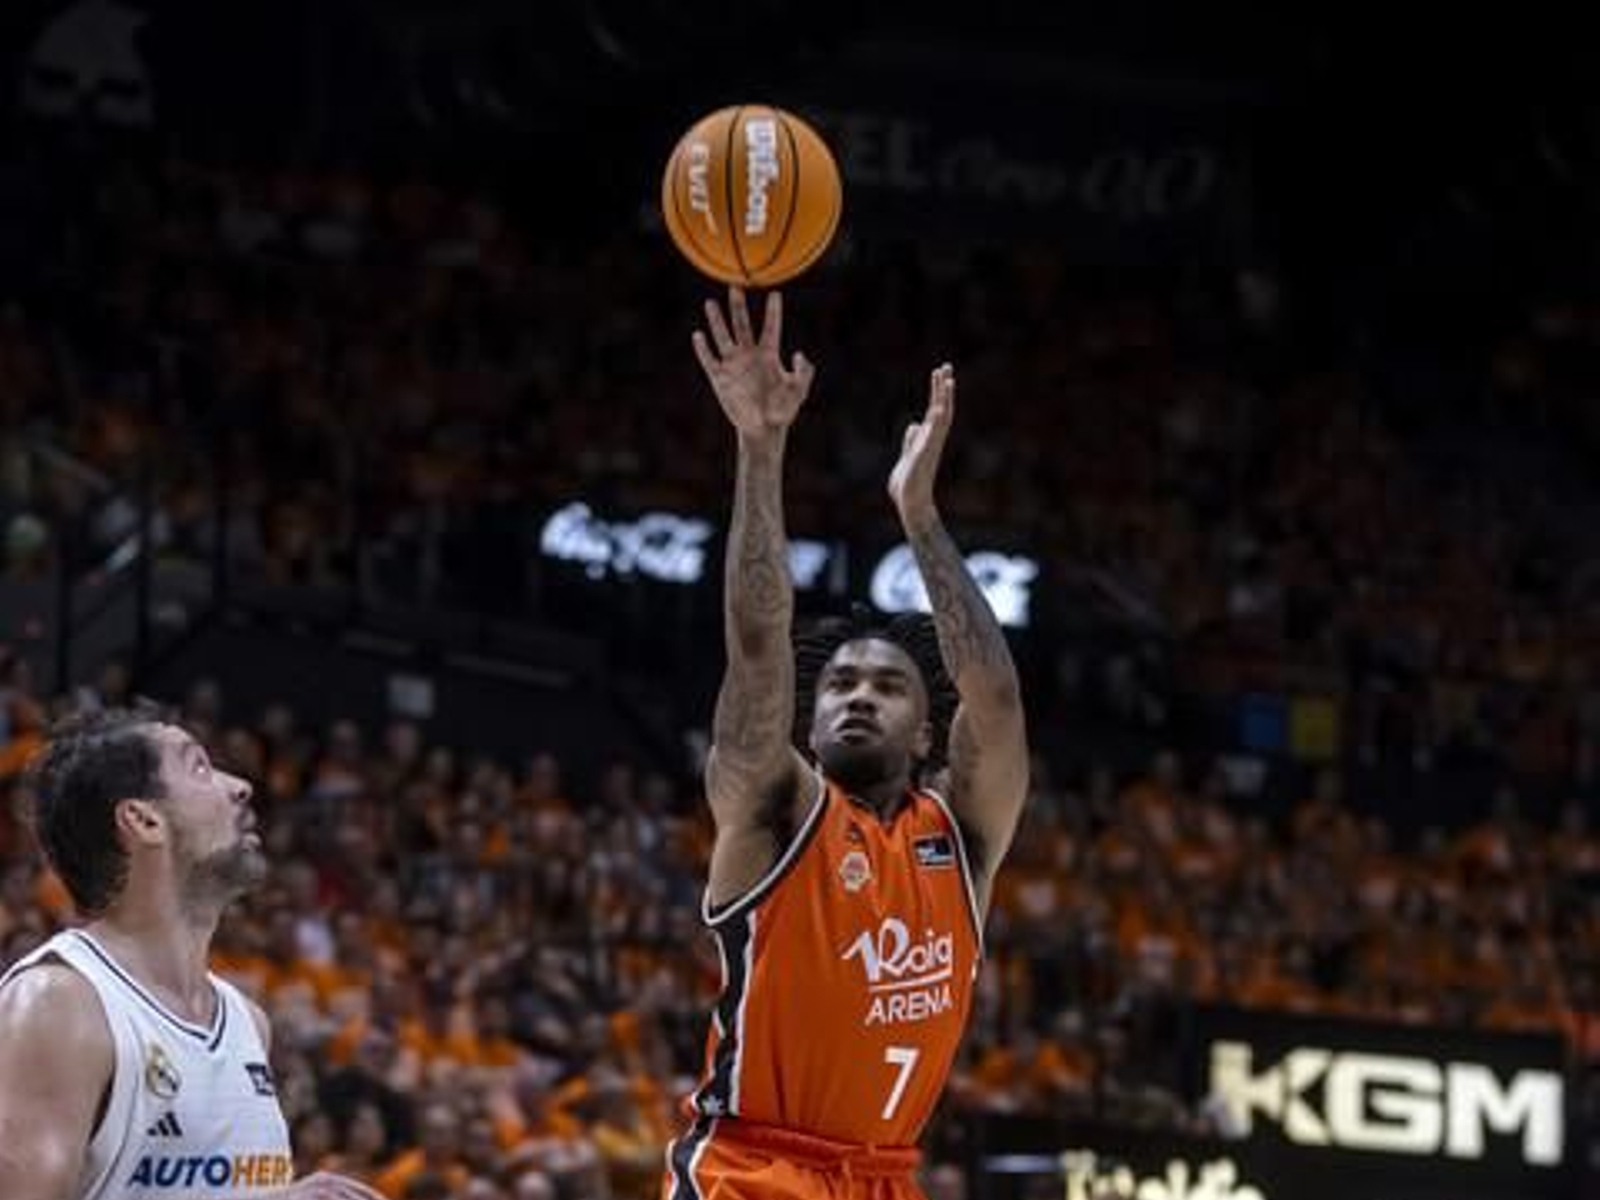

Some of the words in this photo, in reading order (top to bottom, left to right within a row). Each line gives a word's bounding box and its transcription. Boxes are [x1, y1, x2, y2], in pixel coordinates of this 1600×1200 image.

[865, 985, 953, 1027] ARENA
[881, 1046, 919, 1120] 7
[1210, 1039, 1564, 1166] KGM
[128, 1154, 294, 1189] AUTOHER
